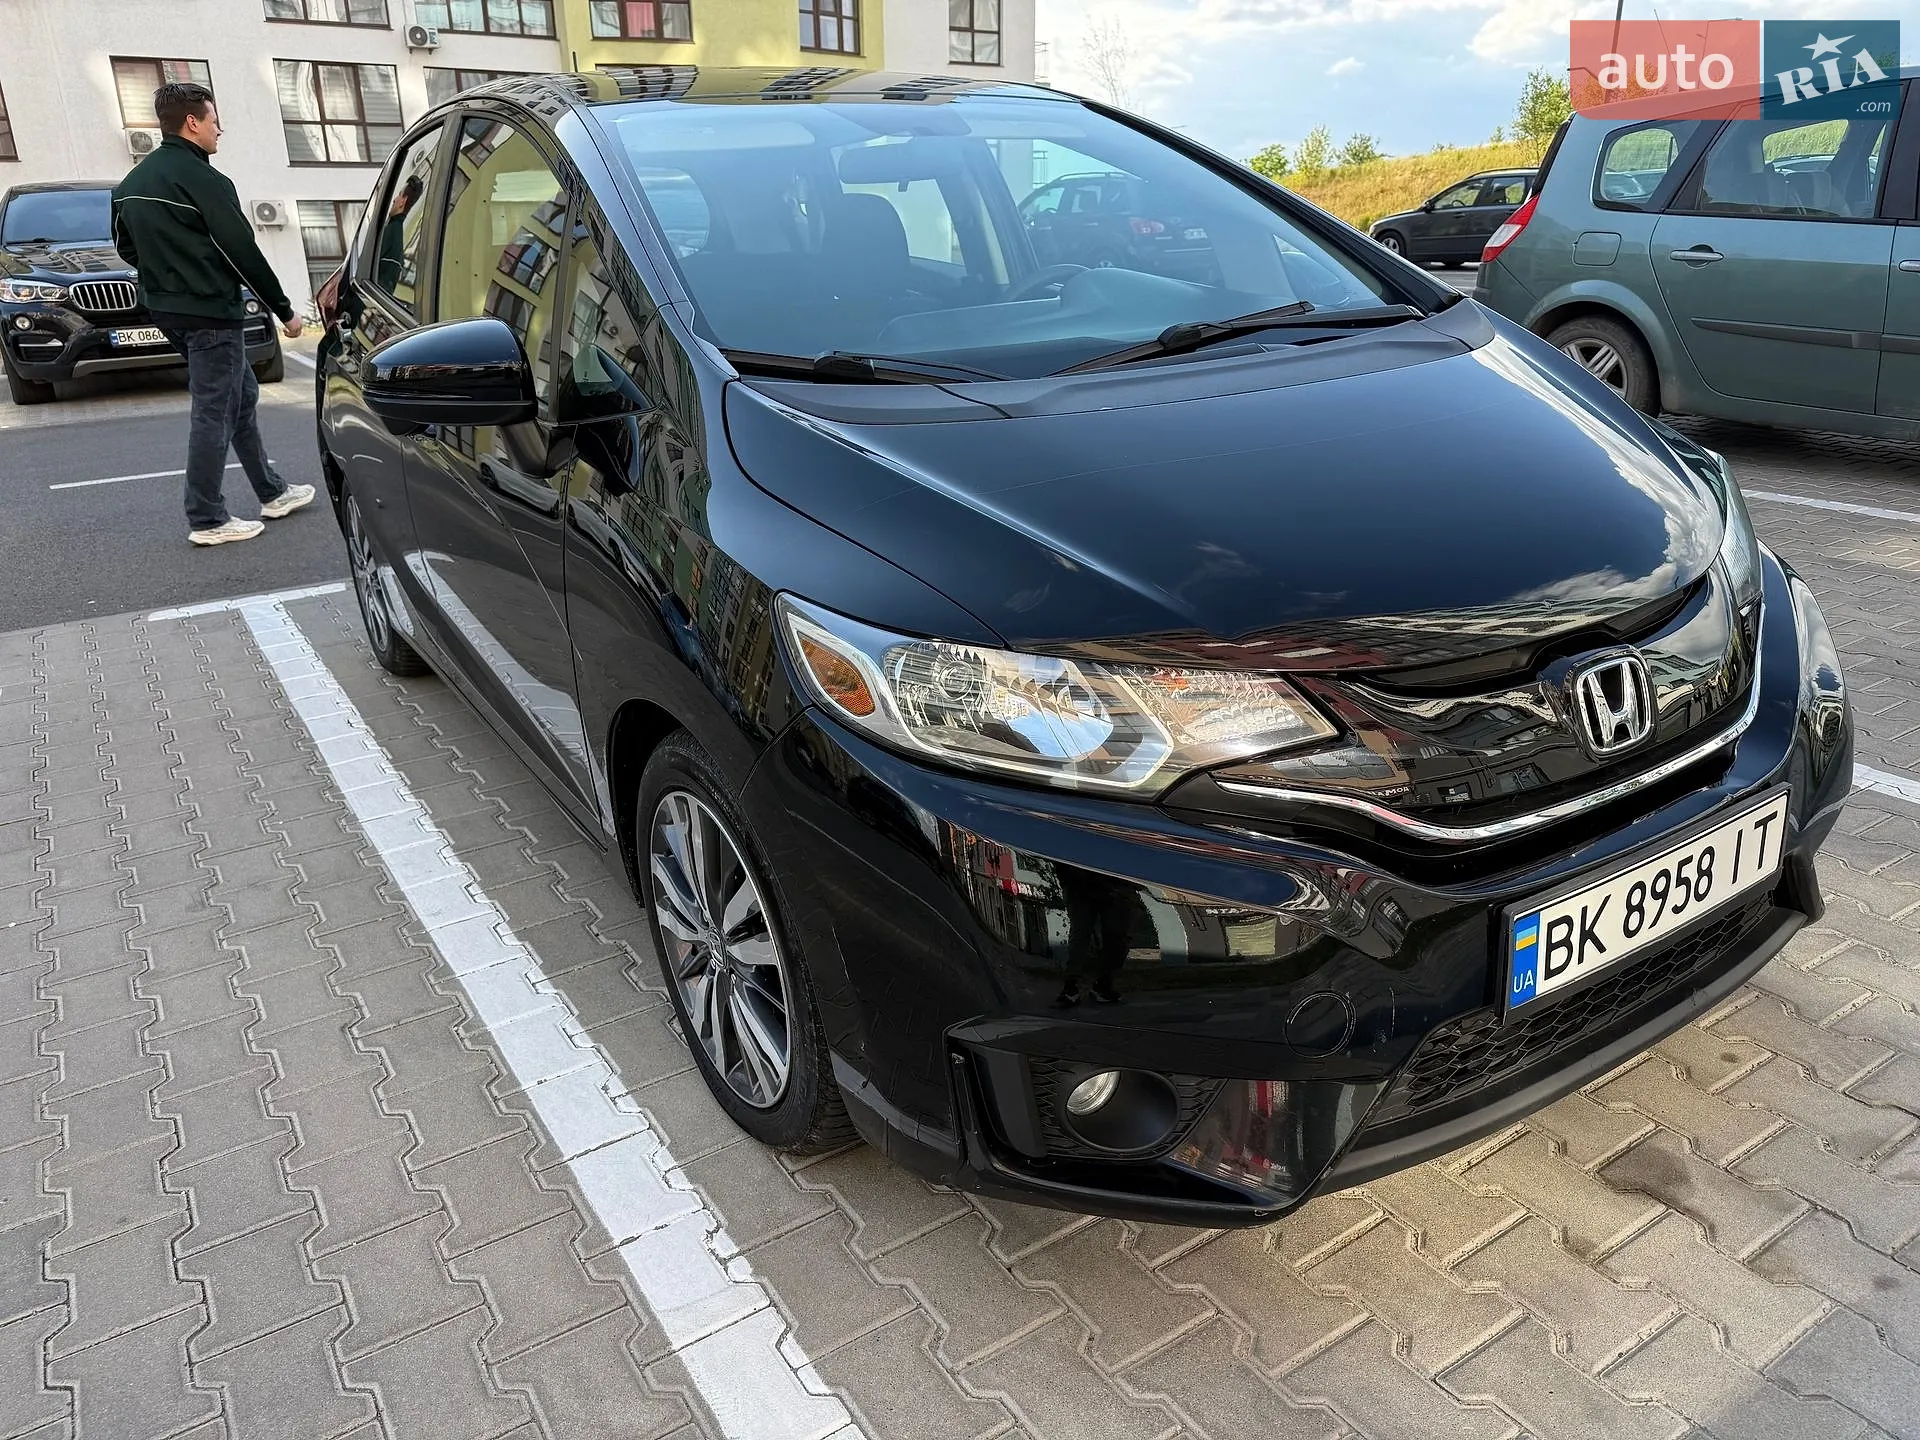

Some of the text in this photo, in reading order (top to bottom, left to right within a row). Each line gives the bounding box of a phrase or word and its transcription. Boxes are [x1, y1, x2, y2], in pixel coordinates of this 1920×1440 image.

[118, 331, 135, 343] BK
[1543, 893, 1612, 981] BK
[1622, 845, 1716, 939] 8958
[1513, 969, 1535, 993] UA
